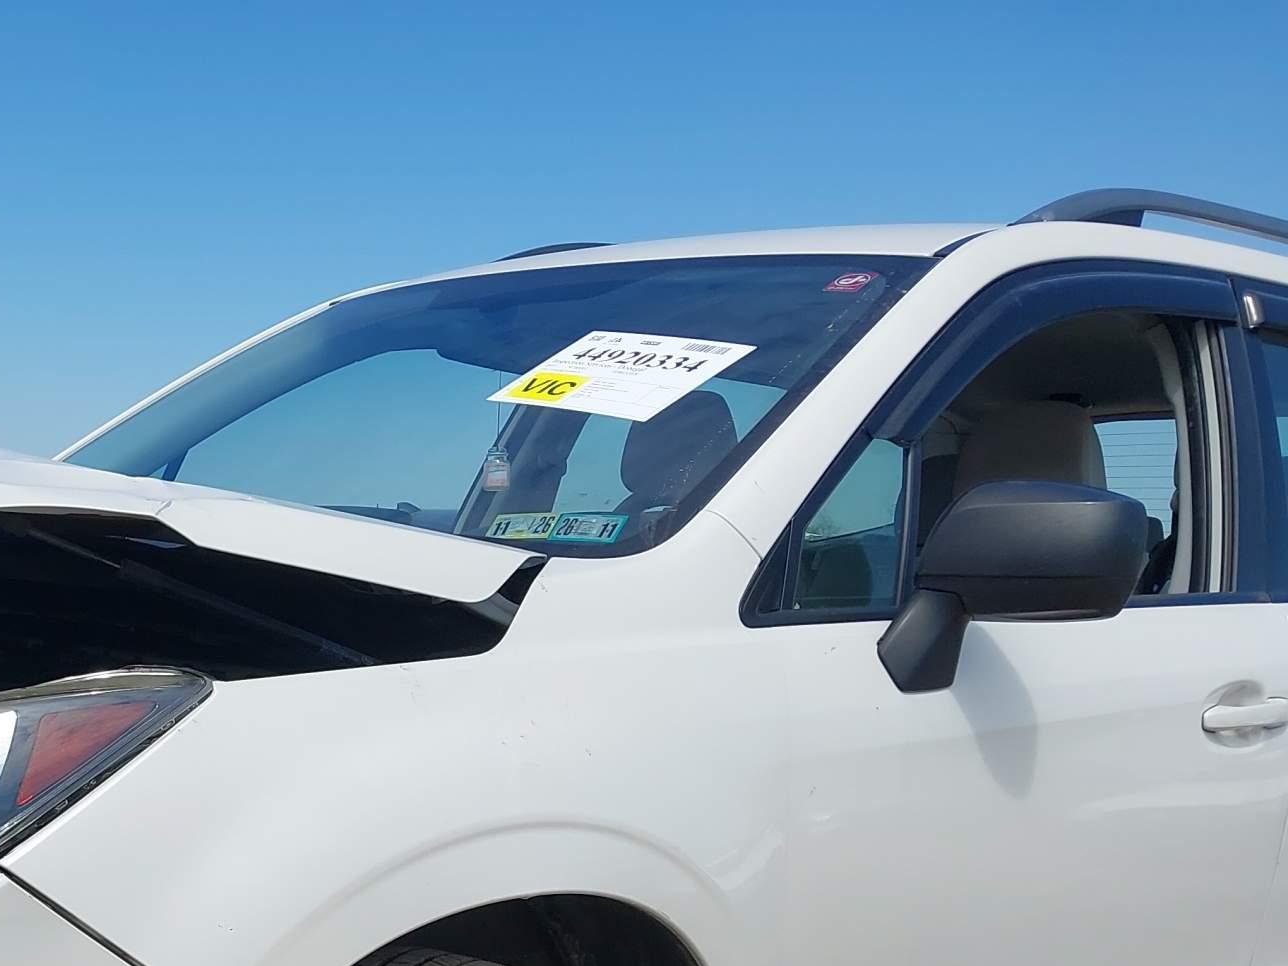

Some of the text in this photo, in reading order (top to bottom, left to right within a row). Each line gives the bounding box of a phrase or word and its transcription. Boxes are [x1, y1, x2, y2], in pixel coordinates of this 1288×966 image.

[572, 346, 709, 373] 44920334
[521, 377, 577, 396] VIC
[533, 516, 556, 534] 26
[556, 518, 579, 536] 26
